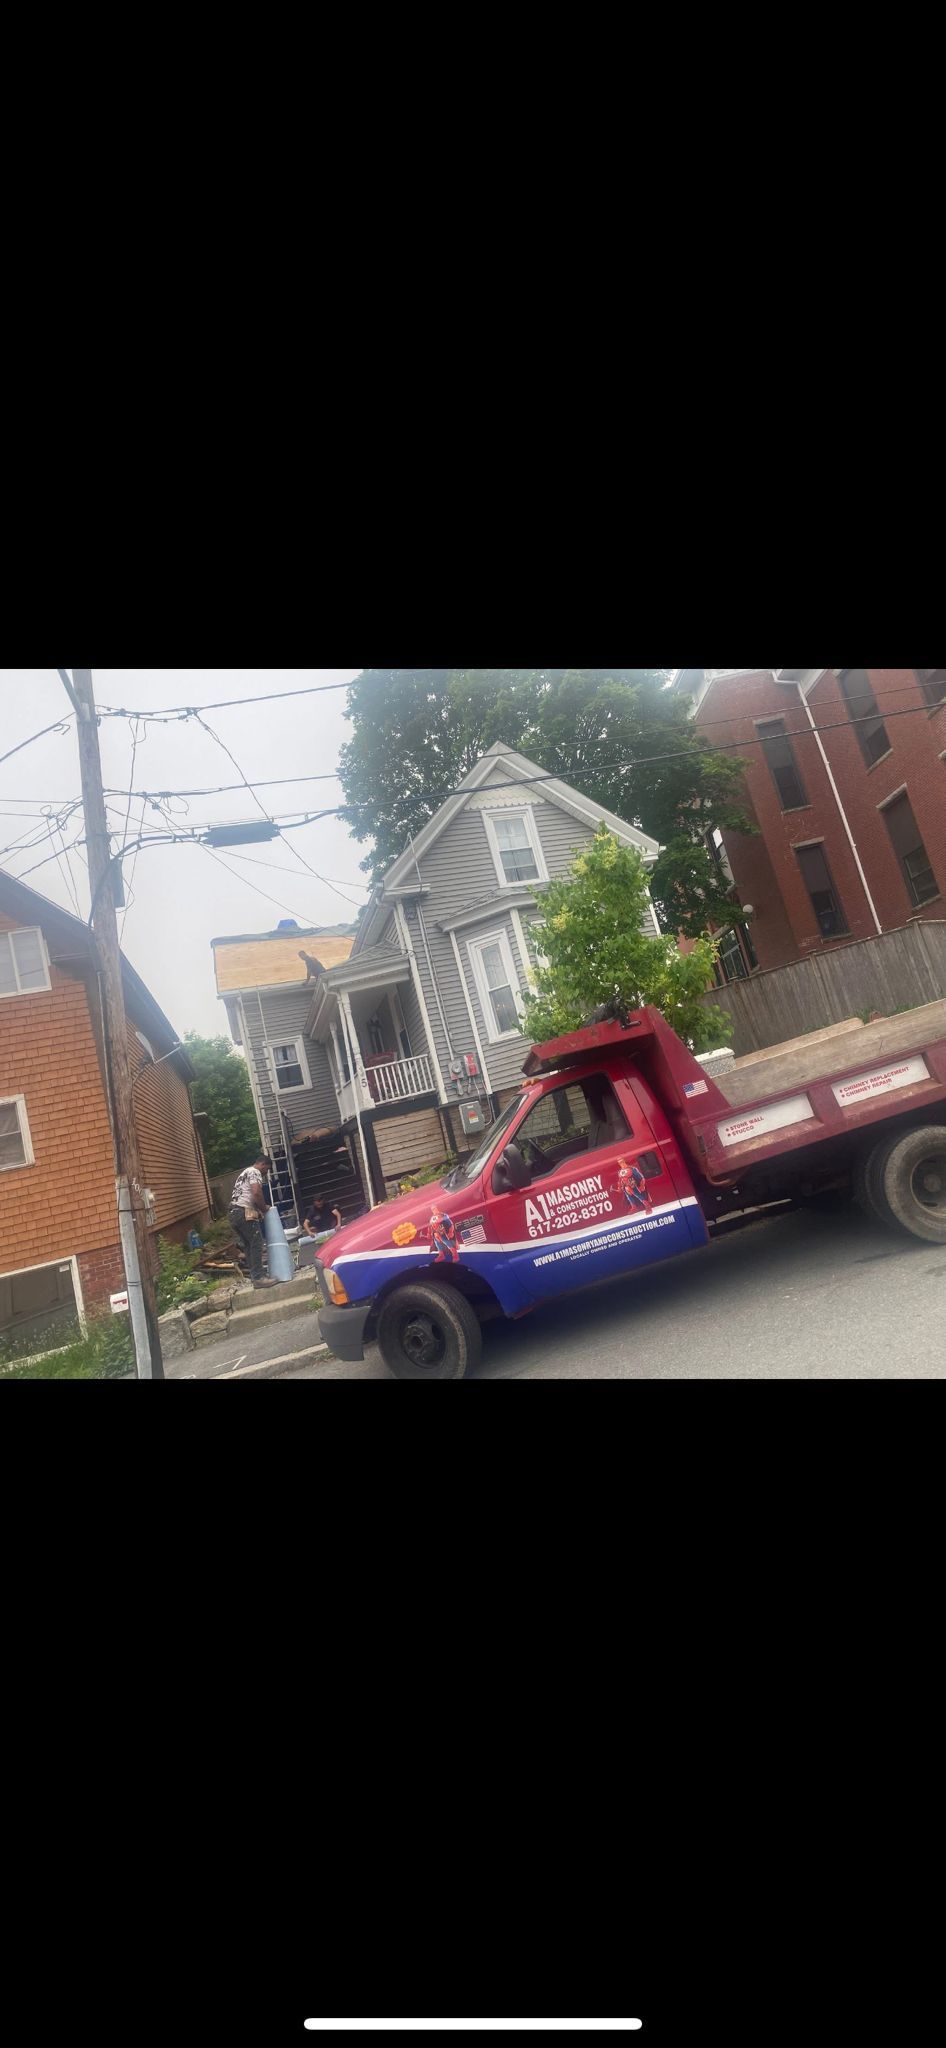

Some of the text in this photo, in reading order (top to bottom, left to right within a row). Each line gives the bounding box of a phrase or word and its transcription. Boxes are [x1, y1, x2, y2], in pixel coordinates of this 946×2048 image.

[843, 1066, 910, 1093] CHIMNEY REPLACEMENT
[845, 1078, 892, 1097] CHIMNEY REPAIR
[730, 1116, 765, 1132] STONE WALL
[731, 1125, 755, 1137] STUCCO
[525, 1175, 603, 1227] A1 MASONRY
[550, 1190, 610, 1217] & CONSTRUCTION
[528, 1200, 613, 1238] 617-202-8370
[533, 1214, 676, 1267] WWW.A1MASONRYANDCONSTRUCTION.COM
[570, 1252, 591, 1261] LOCALLY
[591, 1245, 608, 1254] OWNED
[618, 1234, 643, 1245] OPERATED
